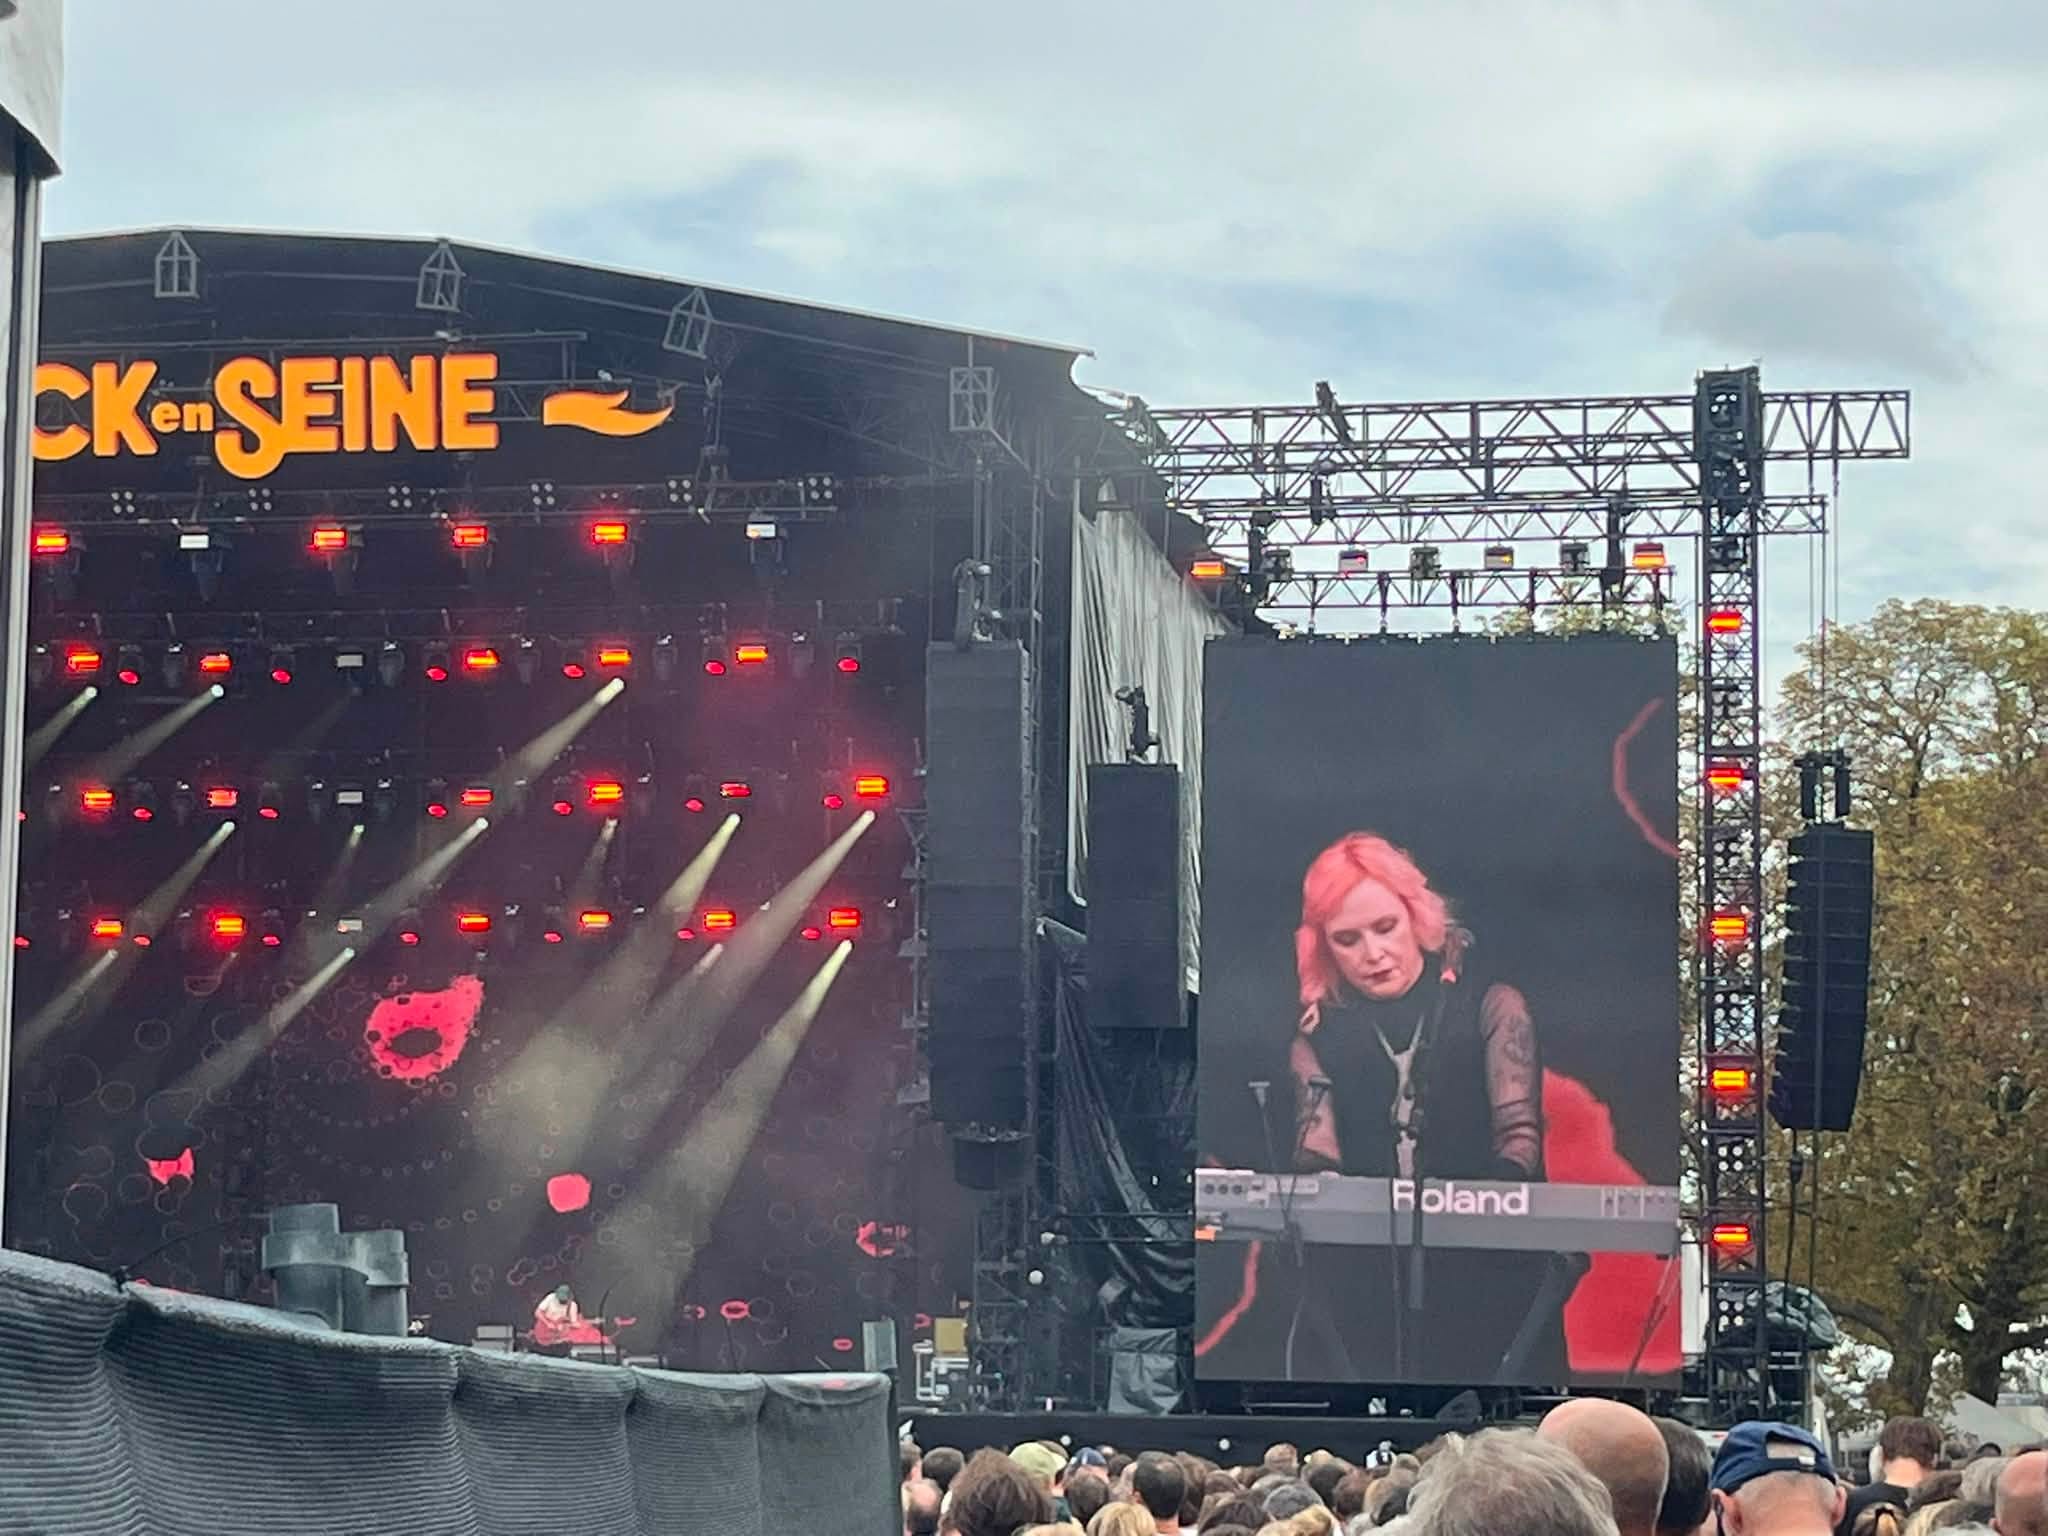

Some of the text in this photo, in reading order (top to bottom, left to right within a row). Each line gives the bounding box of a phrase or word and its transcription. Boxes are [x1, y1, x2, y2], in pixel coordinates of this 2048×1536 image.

[151, 401, 214, 432] en
[214, 354, 499, 479] SEINE
[1392, 1178, 1529, 1215] Roland
